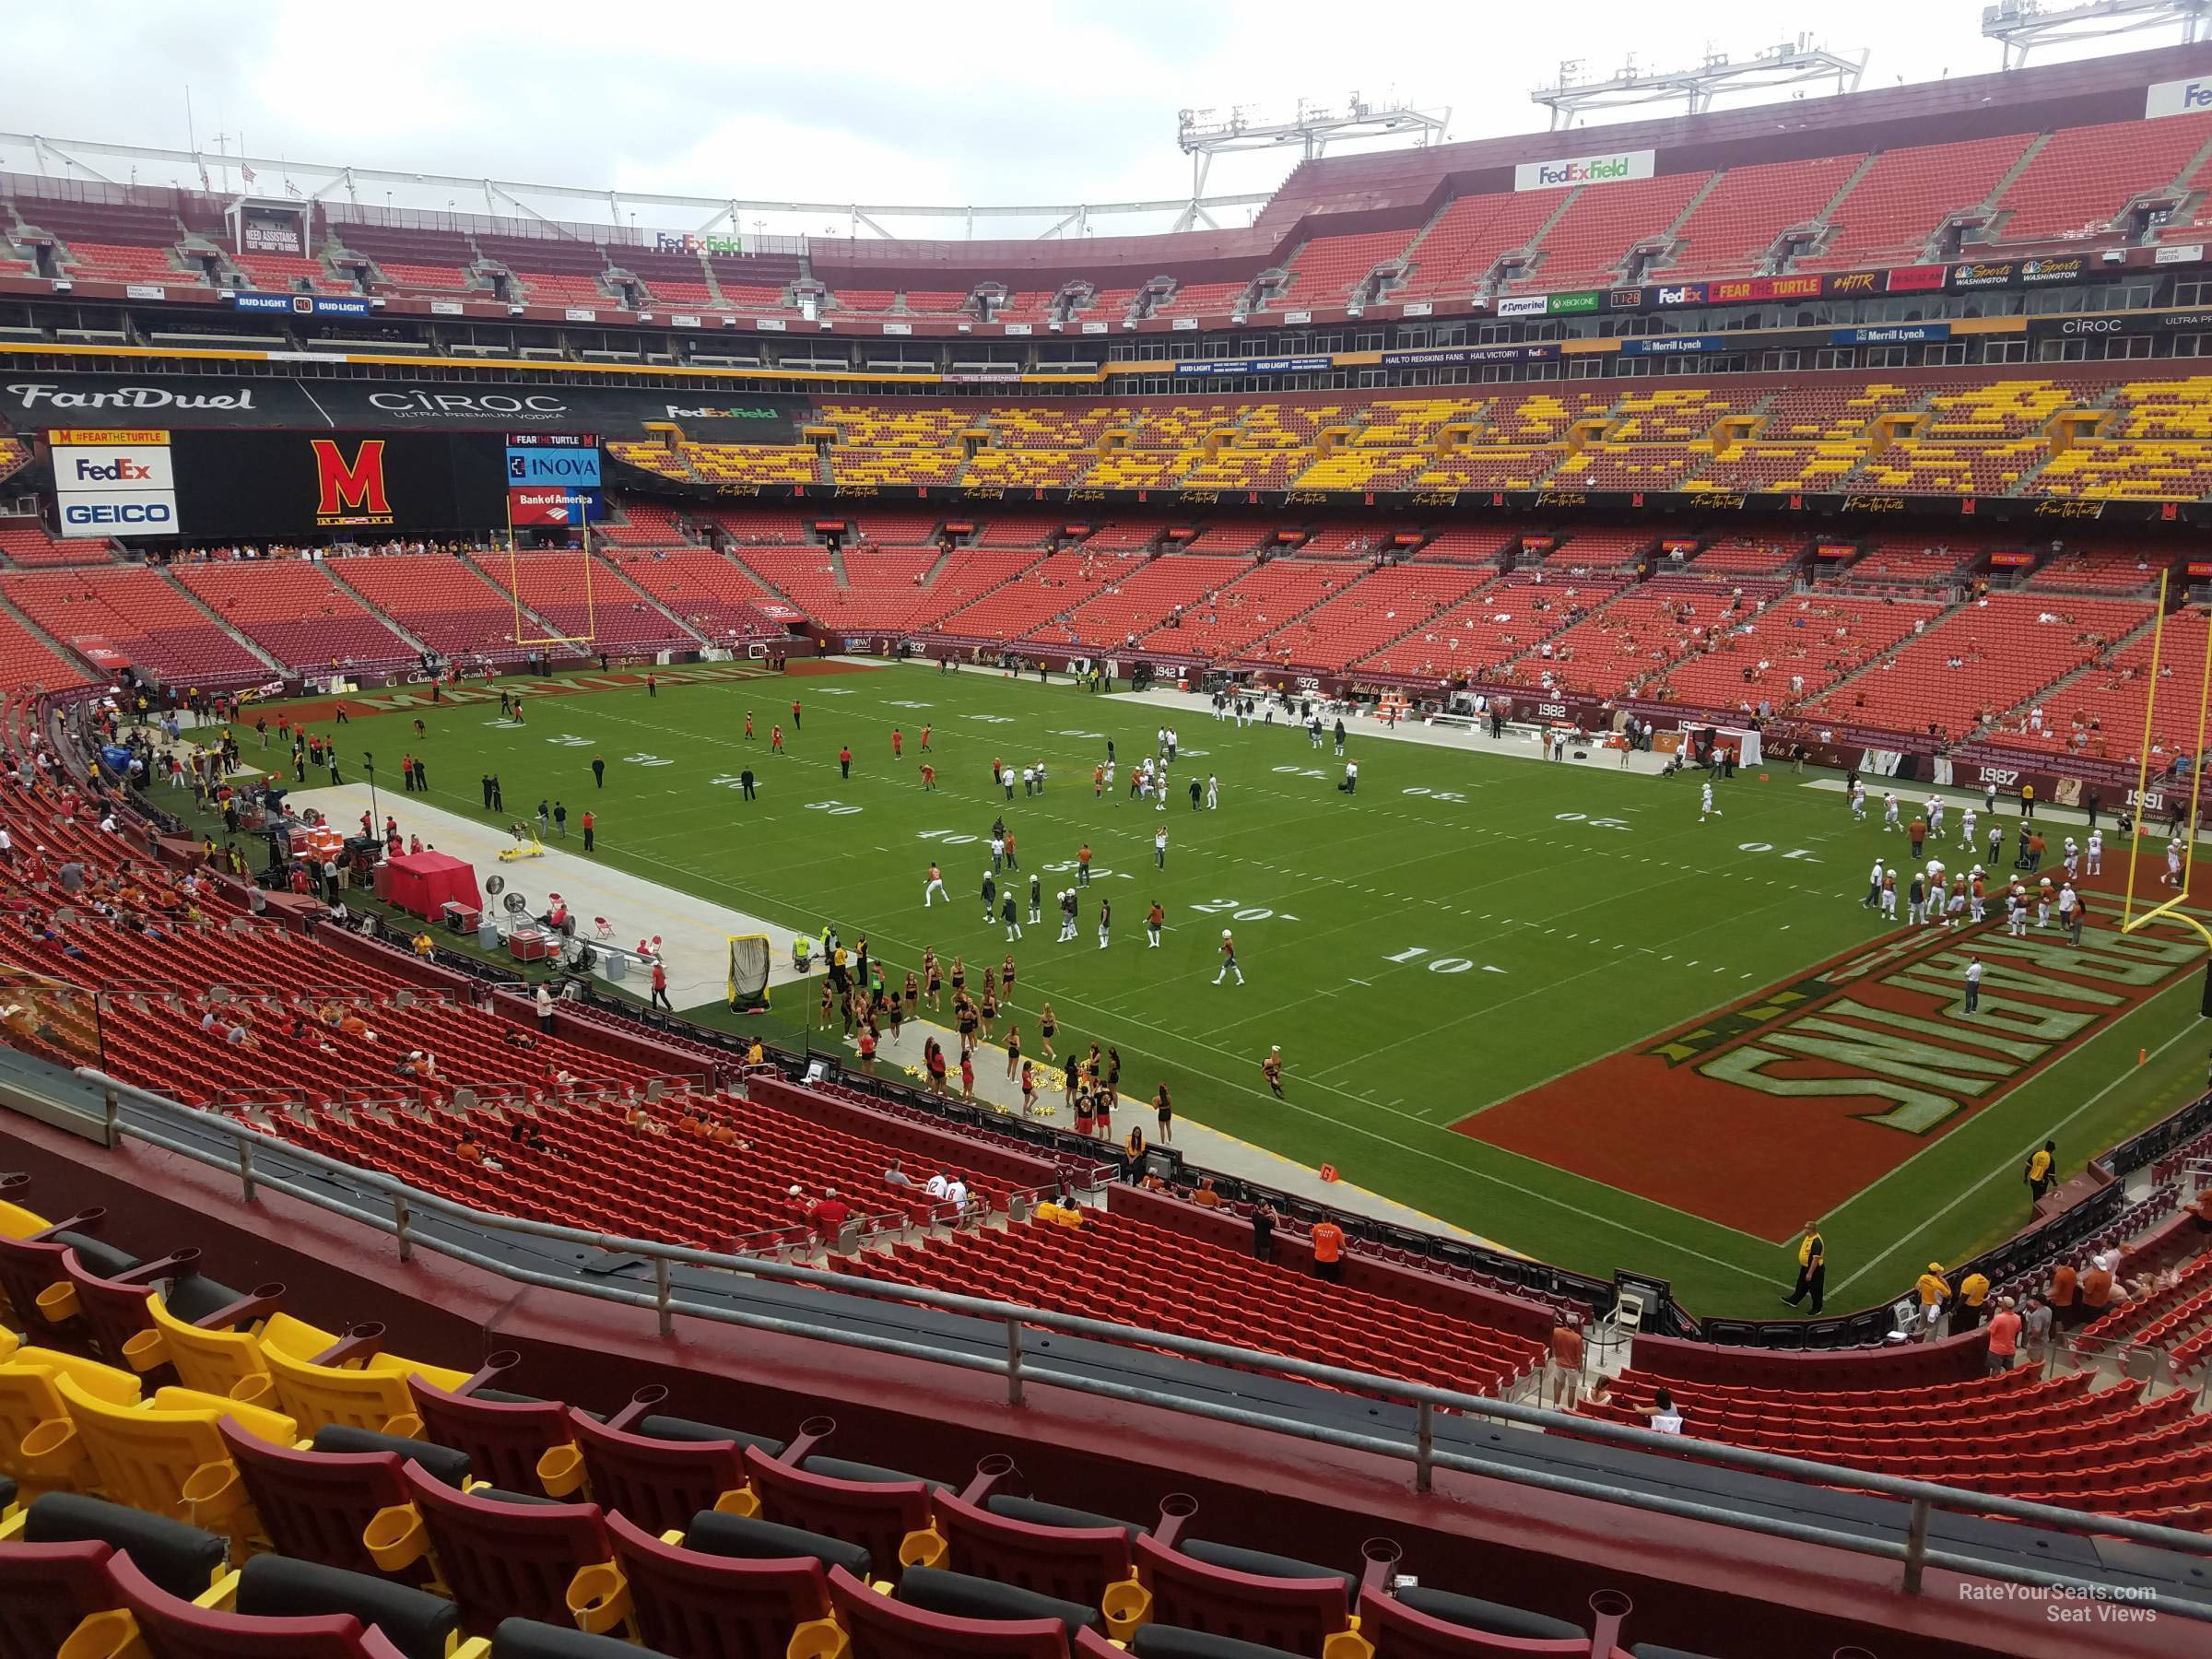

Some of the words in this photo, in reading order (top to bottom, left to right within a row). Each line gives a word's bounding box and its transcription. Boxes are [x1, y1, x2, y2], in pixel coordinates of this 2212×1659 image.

[1539, 157, 1629, 184] FedExField
[246, 229, 262, 240] NEED
[263, 230, 298, 243] ASSISTANCE
[657, 231, 742, 252] FedExField
[246, 240, 258, 249] TEXT
[278, 242, 285, 251] TO
[2157, 254, 2180, 263] GREEN
[1972, 264, 2013, 278] Sports
[2040, 258, 2081, 274] Sports
[1956, 276, 2008, 287] WASHINGTON
[2022, 271, 2077, 282] WASHINGTON
[1712, 279, 1818, 299] #FEARTHETURTLE
[1833, 274, 1875, 294] #HTTR
[1562, 299, 1579, 307] XBOX
[1580, 298, 1594, 306] ONE
[1658, 287, 1701, 304] FedEx
[240, 298, 259, 307] BUD
[260, 299, 288, 308] LIGHT
[295, 300, 310, 311] 40
[318, 301, 338, 311] BUD
[338, 303, 365, 312] LIGHT
[1507, 300, 1546, 312] Ameritel
[2166, 316, 2197, 325] ULTRA
[1868, 330, 1898, 340] Merrill
[1899, 328, 1924, 339] Lynch
[1653, 341, 1677, 350] Merrill
[1678, 340, 1701, 350] Lynch
[1385, 356, 1400, 364] HAIL
[1400, 356, 1409, 364] TO
[1411, 354, 1444, 363] REDSKINS
[1445, 353, 1465, 361] FANS.
[1470, 351, 1485, 360] HAIL
[1486, 350, 1519, 359] VICTORY!
[1528, 348, 1548, 357] FedEx
[1194, 364, 1212, 372] LIGHT
[1270, 361, 1289, 370] LIGHT
[6, 383, 257, 409] FanDuel
[368, 389, 568, 412] CÎROC
[444, 411, 515, 419] PREMIUM
[516, 412, 566, 420] VODKA
[665, 405, 779, 418] FedExField
[76, 432, 160, 442] #FEARTHETURTLE
[512, 436, 580, 444] #FEARTHETURTLE
[76, 458, 152, 481] FedEx
[532, 458, 597, 476] INOVA
[311, 440, 393, 514] M
[520, 495, 544, 505] Bank
[544, 495, 555, 504] of
[65, 504, 170, 524] GEICO
[909, 641, 927, 653] 937
[1155, 666, 1176, 678] 1942
[352, 666, 786, 711] MARYLAND
[1297, 677, 1319, 688] 1972
[1538, 702, 1566, 718] 1982
[545, 733, 595, 747] 20
[623, 751, 676, 768] 30
[1979, 766, 2019, 786] 1987
[2125, 789, 2163, 811] 1991
[803, 799, 864, 816] 50
[915, 828, 979, 845] 40
[1042, 858, 1113, 879] 30
[1191, 898, 1274, 922] 20
[1382, 945, 1475, 974] 10
[928, 1180, 939, 1194] 12
[947, 1187, 957, 1201] 8
